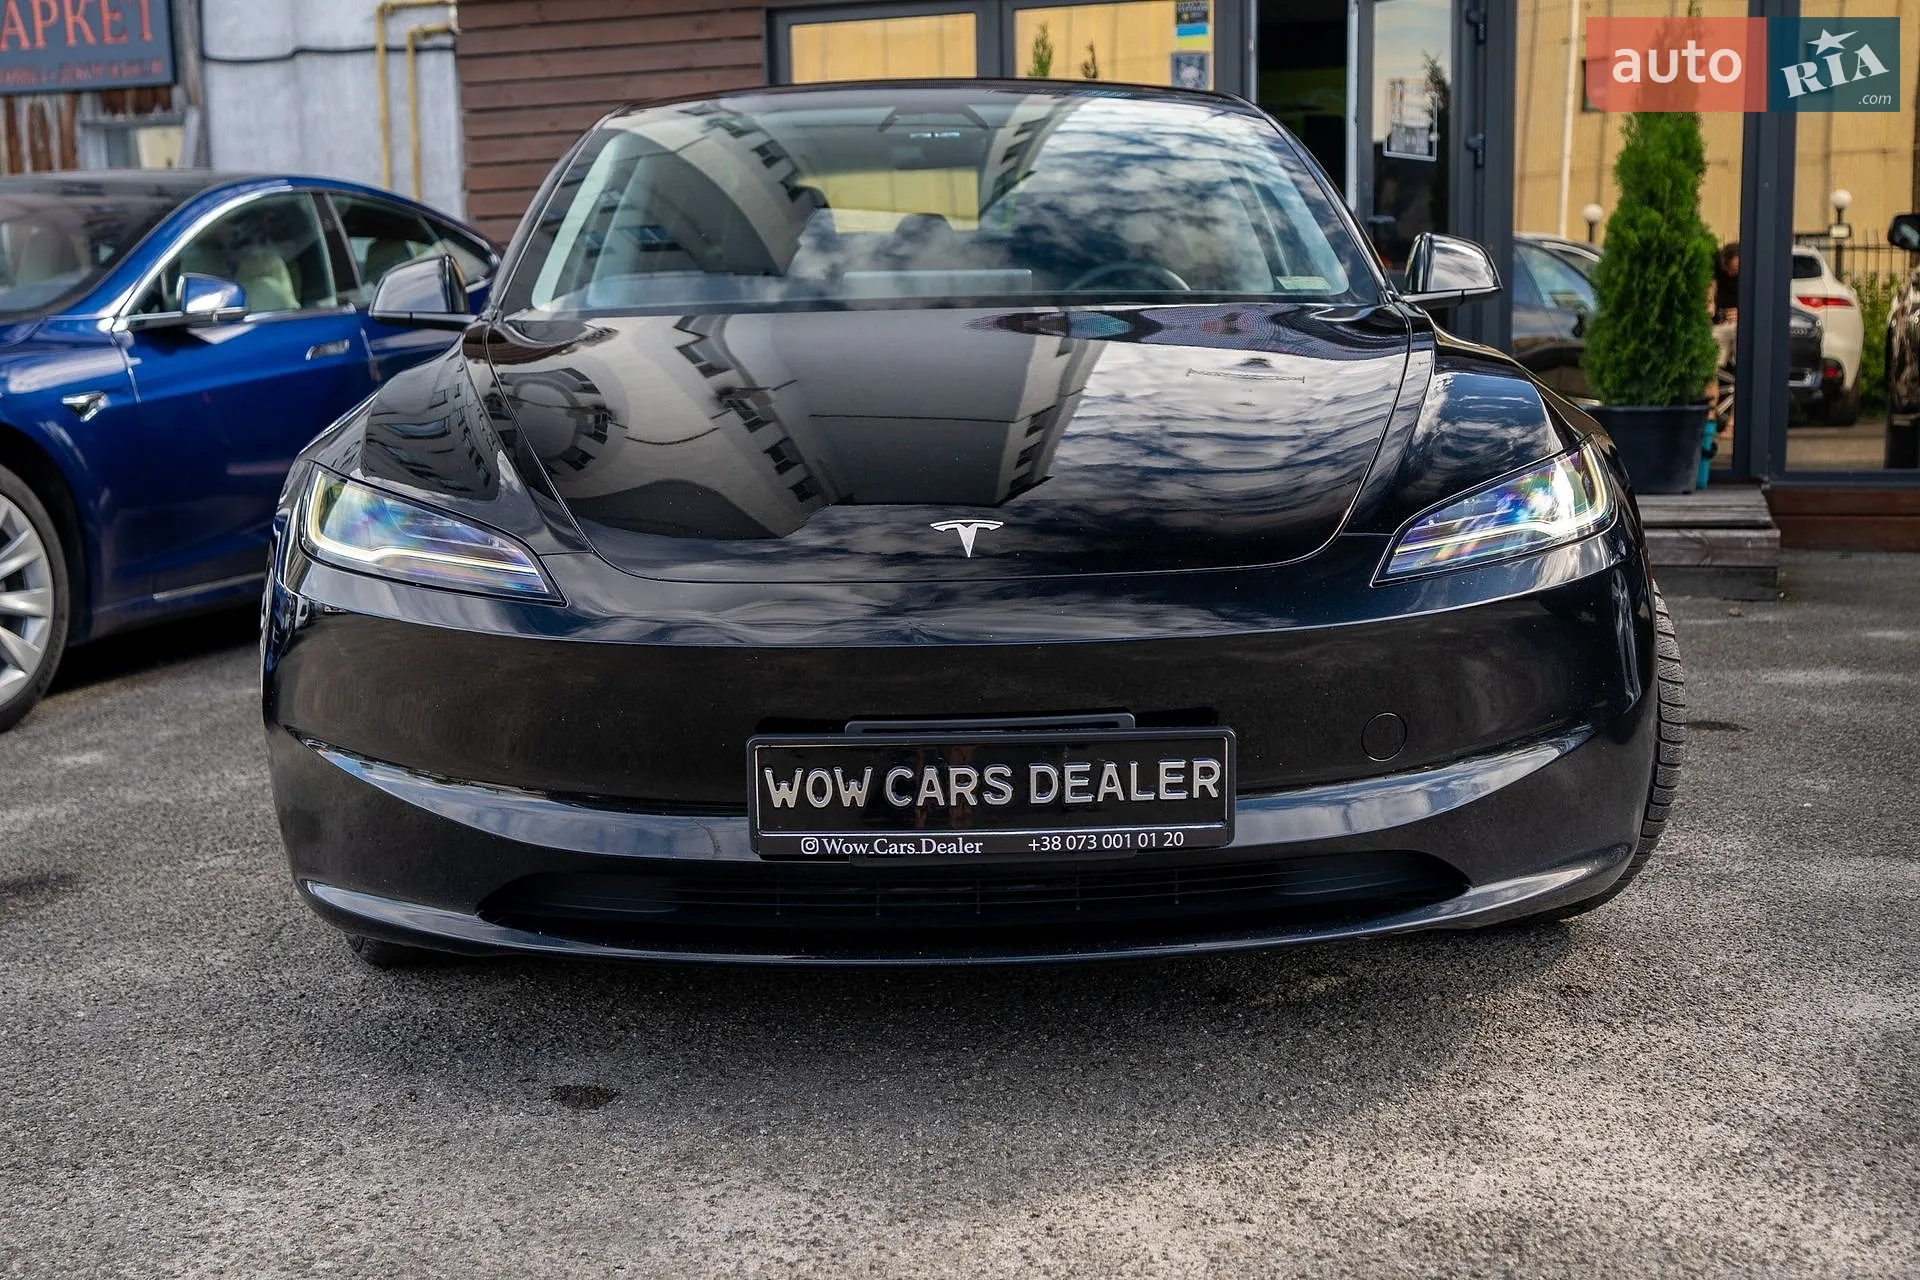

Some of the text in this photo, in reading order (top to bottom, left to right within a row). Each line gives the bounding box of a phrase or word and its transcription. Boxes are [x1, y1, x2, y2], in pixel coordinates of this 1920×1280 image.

[764, 758, 1221, 808] WOW CARS DEALER
[1028, 831, 1184, 851] +38 073 001 01 20
